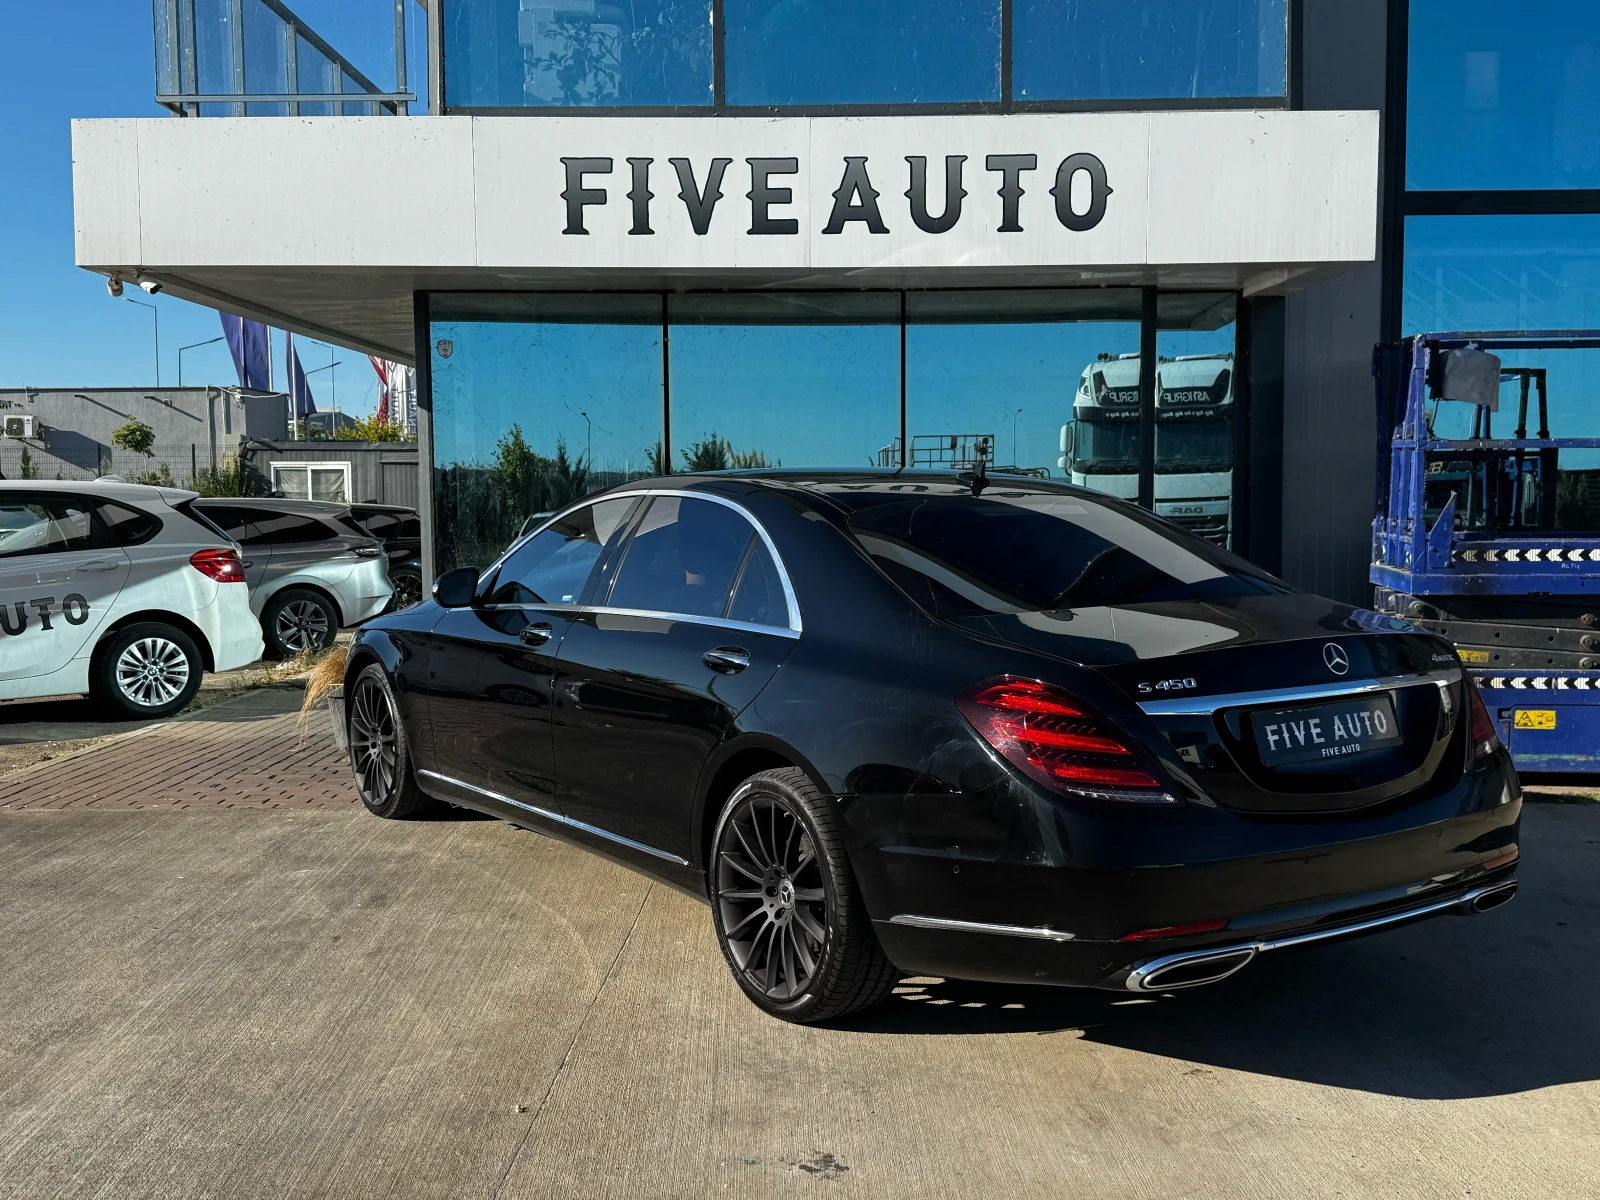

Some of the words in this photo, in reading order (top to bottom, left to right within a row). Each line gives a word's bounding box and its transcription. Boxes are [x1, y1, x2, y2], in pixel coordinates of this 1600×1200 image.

[559, 156, 799, 235] FIVE
[821, 152, 1113, 235] AUTO
[0, 593, 90, 636] UTO
[1138, 682, 1153, 693] S
[1155, 677, 1198, 691] 450
[1264, 718, 1326, 751] FIVE
[1333, 709, 1387, 741] AUTO
[1321, 746, 1340, 757] FIVE
[1341, 743, 1361, 754] AUTO
